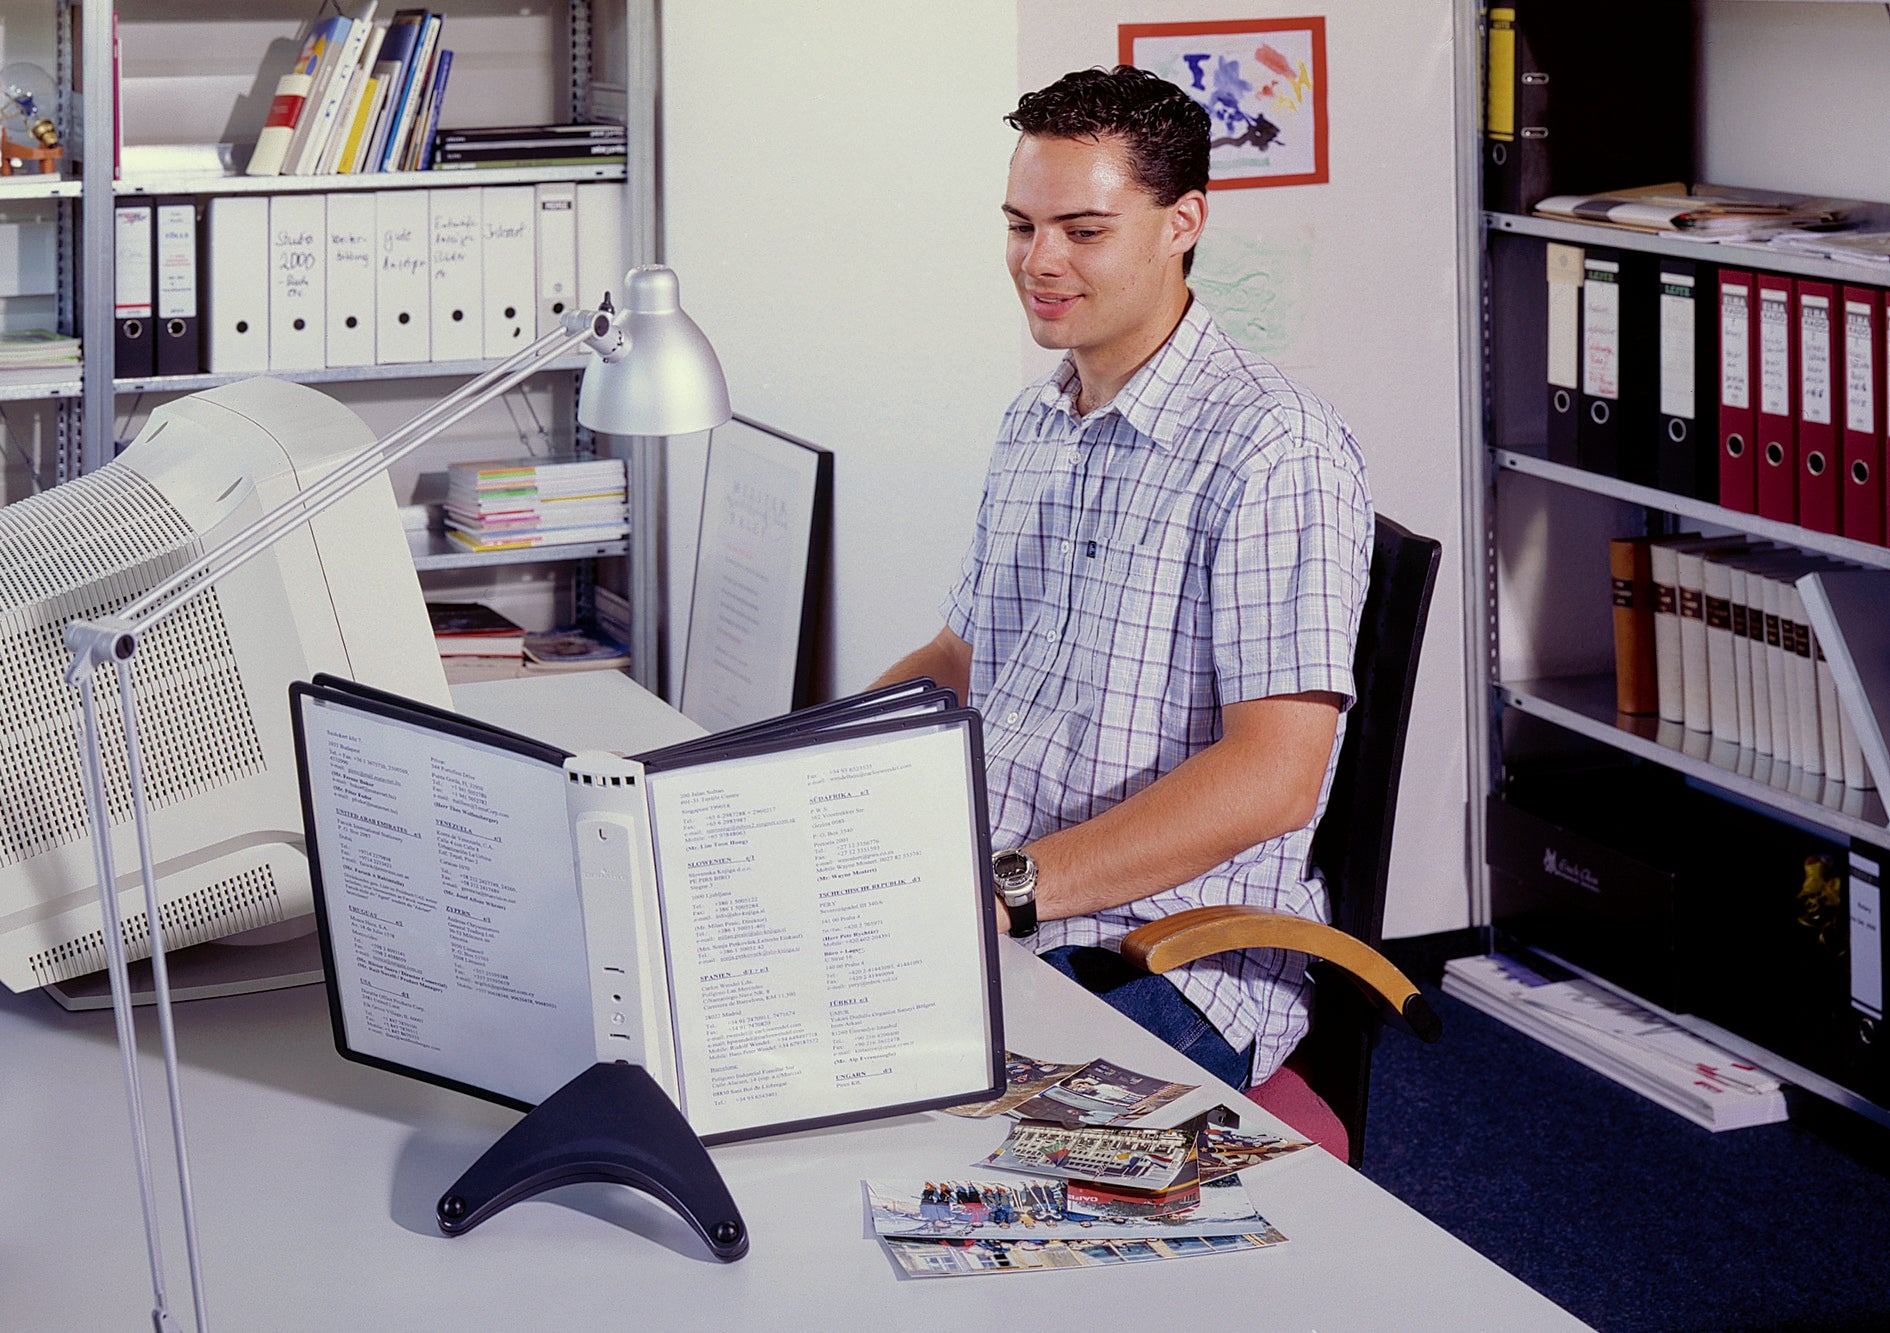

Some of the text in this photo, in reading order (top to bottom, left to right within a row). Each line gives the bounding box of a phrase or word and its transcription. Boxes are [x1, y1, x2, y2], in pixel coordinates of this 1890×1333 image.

[280, 252, 315, 271] 2000
[810, 793, 852, 804] SÜDAFRIKA
[436, 819, 472, 835] VENEZUELA
[688, 858, 732, 868] SLOWENIEN
[820, 886, 869, 898] TSCHECHISCHE
[872, 880, 906, 890] REPUBLIK
[446, 906, 471, 918] ZYPERN
[701, 973, 731, 982] SPANIEN
[836, 1072, 866, 1081] UNGARN
